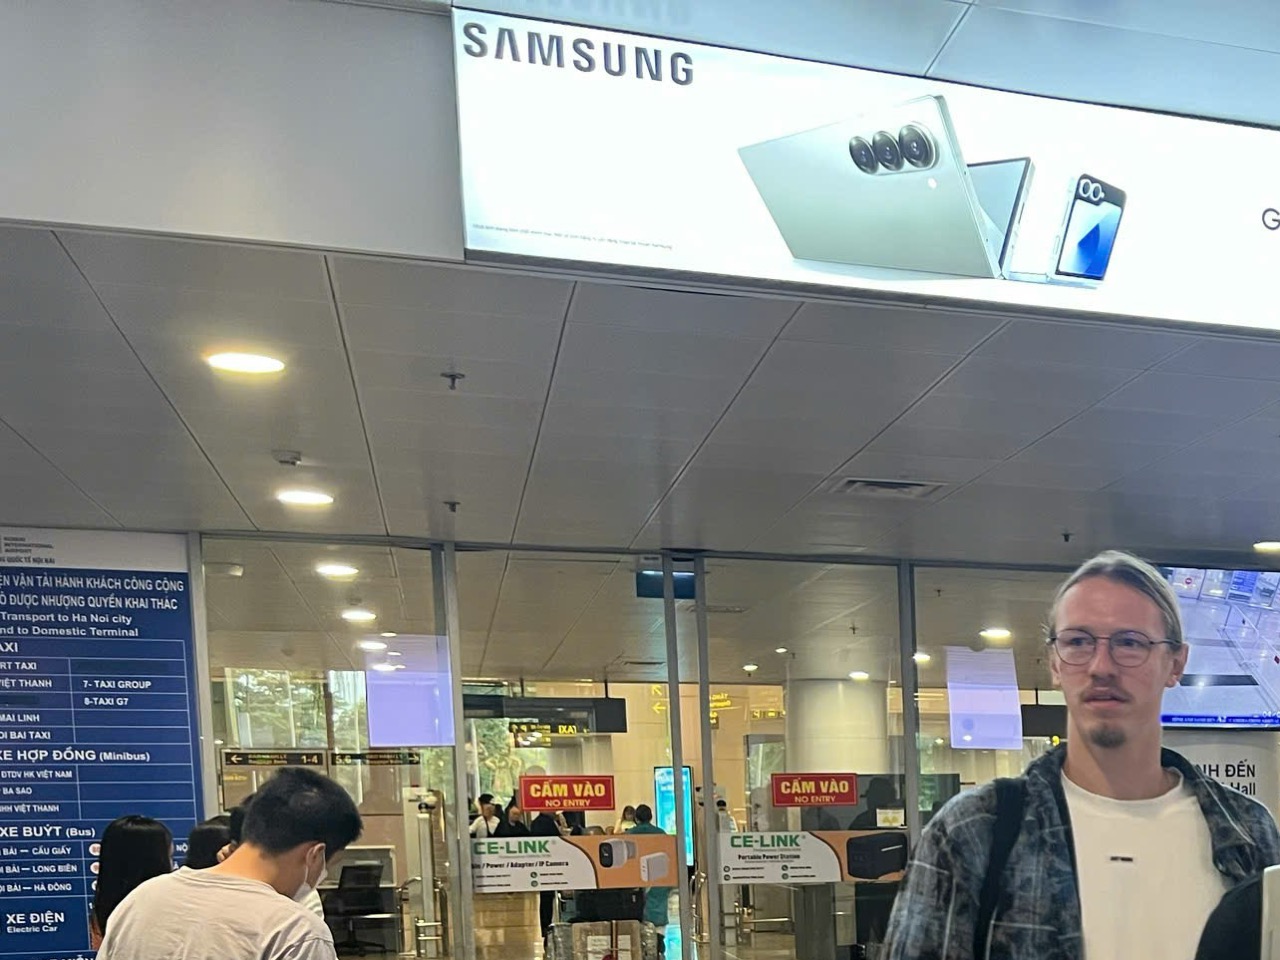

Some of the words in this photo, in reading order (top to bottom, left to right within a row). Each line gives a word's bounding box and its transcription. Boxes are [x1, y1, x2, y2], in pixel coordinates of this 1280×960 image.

[463, 22, 693, 86] SAMSUNG
[13, 572, 34, 589] VẬN
[56, 574, 84, 589] HÀNH
[86, 574, 122, 590] KHÁCH
[123, 576, 153, 591] CÔNG
[155, 577, 184, 593] CỘNG
[9, 594, 39, 610] ĐƯỢC
[41, 594, 85, 610] NHƯỢNG
[125, 597, 149, 609] KHAI
[150, 597, 178, 610] THÁC
[1, 611, 56, 623] Transport
[58, 613, 70, 622] to
[72, 613, 87, 622] Ha
[90, 613, 110, 623] Noi
[112, 614, 133, 625] city
[17, 626, 29, 635] to
[32, 626, 87, 637] Domestic
[89, 627, 139, 637] Terminal
[15, 662, 37, 670] TAXI
[18, 679, 52, 688] THANH
[95, 681, 116, 689] TAXI
[117, 681, 151, 689] GROUP
[116, 698, 129, 706] G7
[18, 714, 40, 722] LINH
[9, 731, 27, 739] BAI
[29, 731, 51, 740] TAXI
[17, 750, 49, 763] HỢP
[99, 751, 151, 762] (Minibus)
[1225, 758, 1256, 778] ĐẾN
[23, 771, 36, 779] HK
[36, 770, 54, 779] VIỆT
[55, 770, 73, 778] NAM
[530, 780, 569, 797] CẤM
[573, 782, 606, 797] VÀO
[780, 777, 816, 794] CẤM
[819, 780, 850, 793] VÀO
[1231, 782, 1256, 796] Hall
[2, 787, 14, 795] BA
[15, 787, 33, 795] SAO
[545, 799, 562, 808] NO
[563, 799, 591, 808] ENTRY
[794, 795, 810, 803] NO
[811, 795, 836, 803] ENTRY
[14, 804, 32, 814] VIỆT
[33, 804, 60, 812] THANH
[22, 823, 62, 837] BUÝT
[65, 827, 96, 837] (Bus)
[730, 834, 801, 848] CE-LINK
[473, 840, 550, 855] CE-LINK
[32, 865, 57, 873] LONG
[58, 863, 78, 873] BIÊN
[33, 882, 47, 891] HÀ
[6, 914, 26, 924] XE
[30, 911, 65, 926] ĐIỆN
[6, 926, 41, 934] Electric
[42, 925, 59, 933] Car
